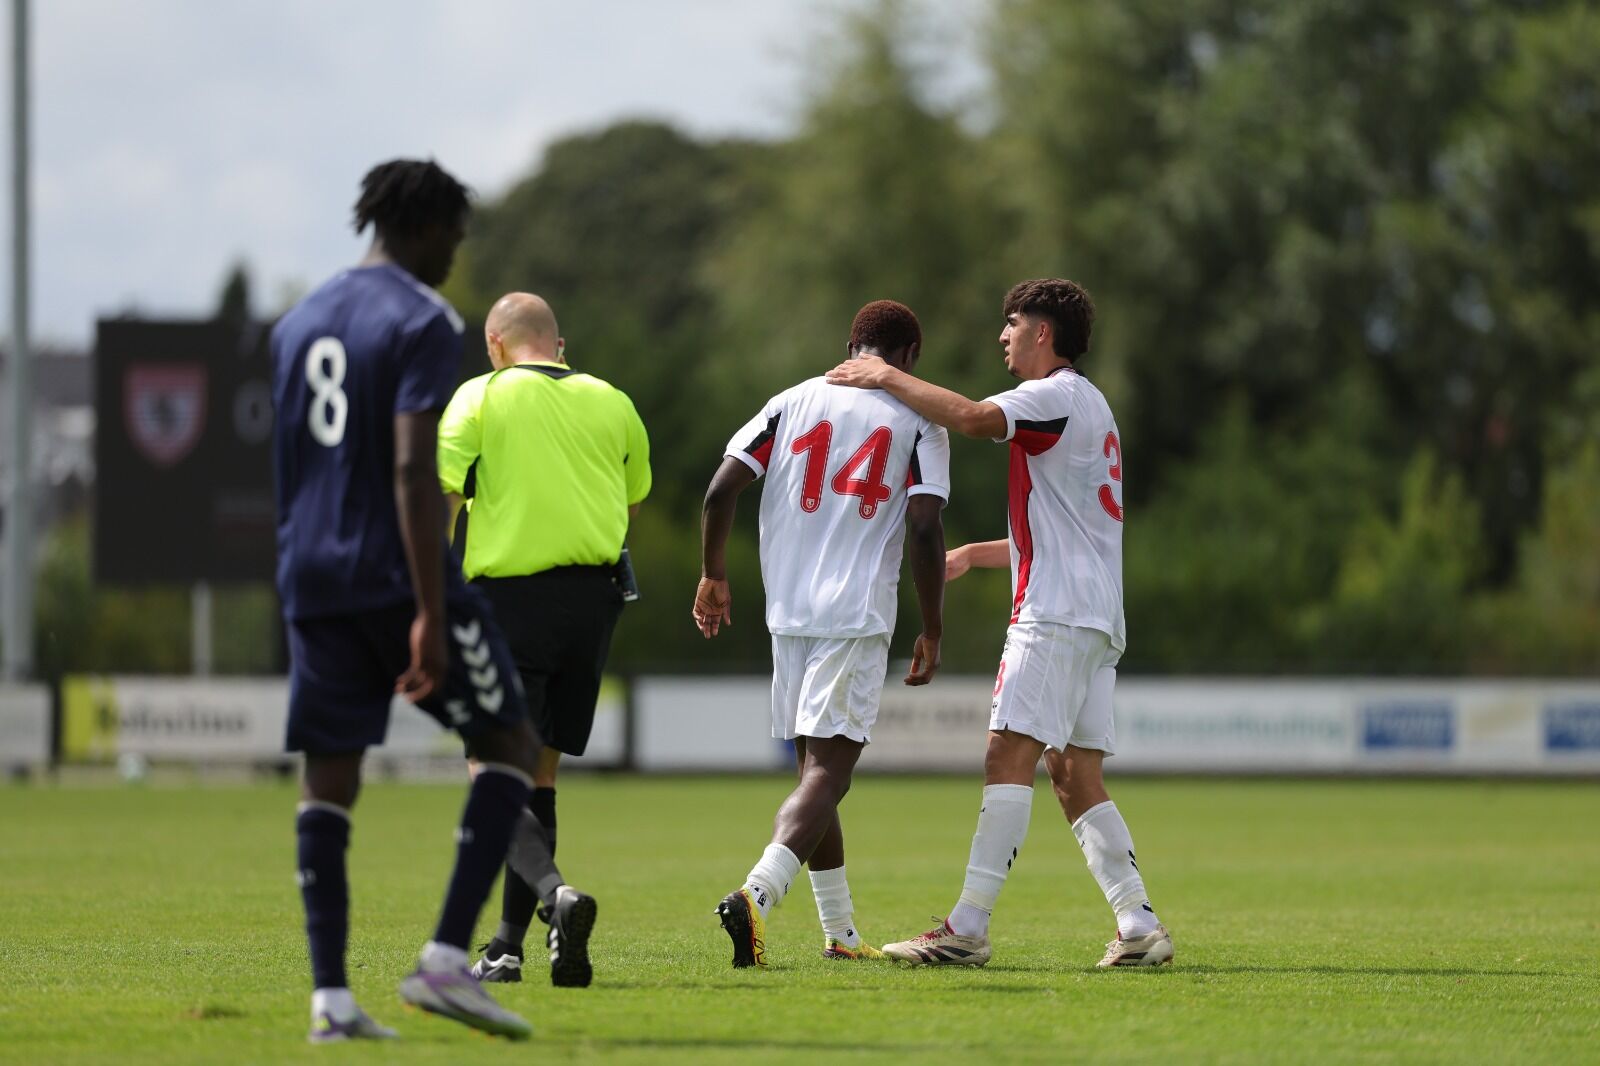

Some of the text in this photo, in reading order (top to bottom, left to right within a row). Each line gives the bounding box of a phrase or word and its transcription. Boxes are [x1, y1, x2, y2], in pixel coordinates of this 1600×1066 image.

[305, 336, 348, 447] 8
[790, 420, 893, 519] 14
[1098, 431, 1124, 522] 3
